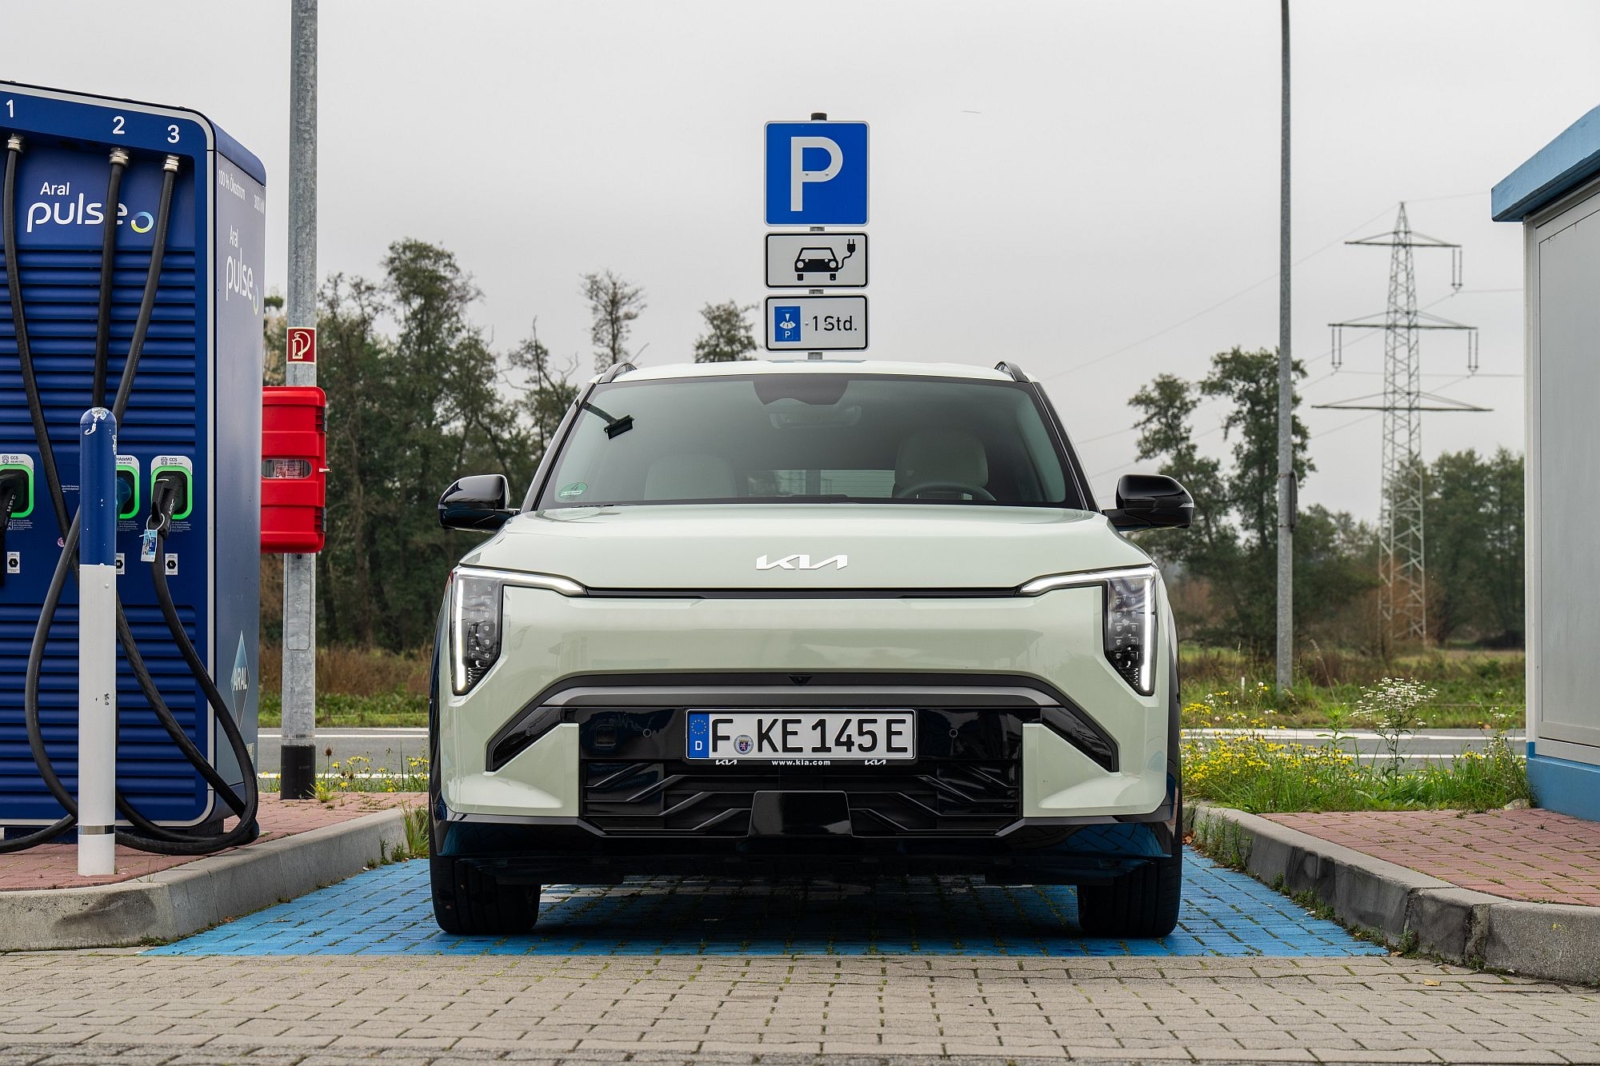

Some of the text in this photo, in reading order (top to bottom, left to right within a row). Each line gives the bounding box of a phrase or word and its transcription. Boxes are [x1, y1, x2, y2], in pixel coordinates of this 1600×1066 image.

[6, 99, 14, 118] 1
[112, 116, 125, 135] 2
[167, 125, 180, 143] 3
[790, 136, 844, 212] P
[40, 181, 70, 196] Aral
[229, 224, 239, 248] Aral
[225, 246, 254, 301] pulse
[823, 315, 858, 332] Std.
[784, 330, 791, 339] P
[756, 554, 848, 570] KIA
[695, 741, 703, 751] D
